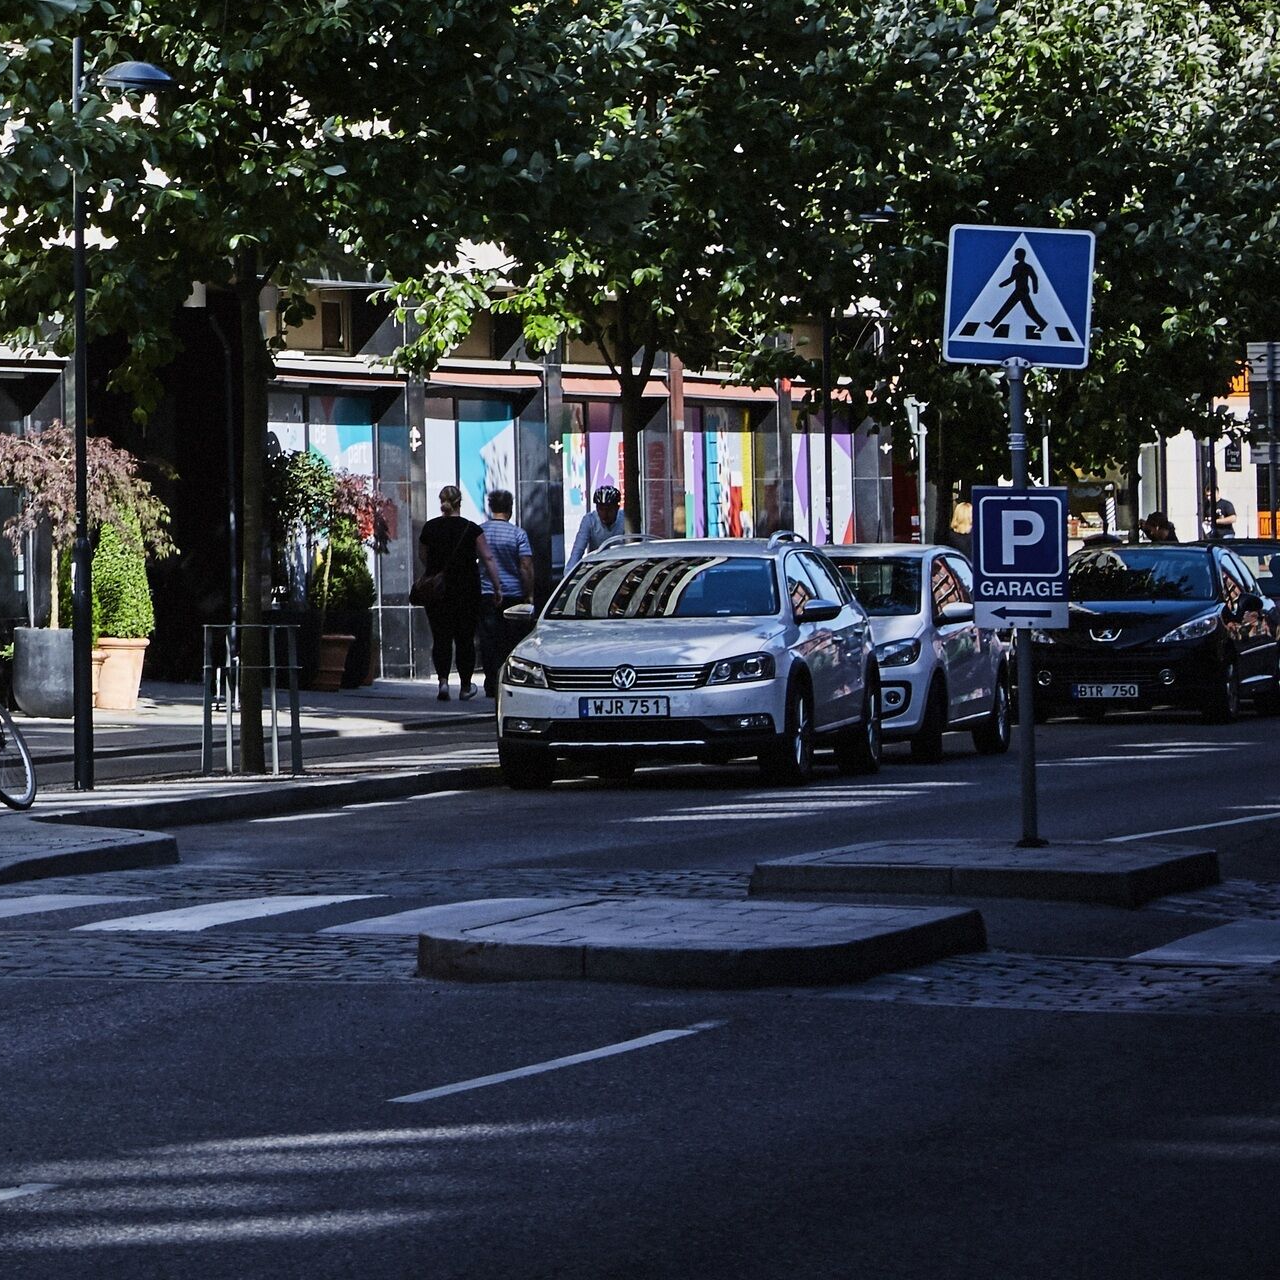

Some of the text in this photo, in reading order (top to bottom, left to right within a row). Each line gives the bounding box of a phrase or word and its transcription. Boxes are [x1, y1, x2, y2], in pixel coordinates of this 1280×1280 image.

[1001, 509, 1046, 566] P
[980, 580, 1064, 597] GARAGE
[1079, 685, 1137, 697] BTR 750
[593, 699, 660, 715] WJR 751
